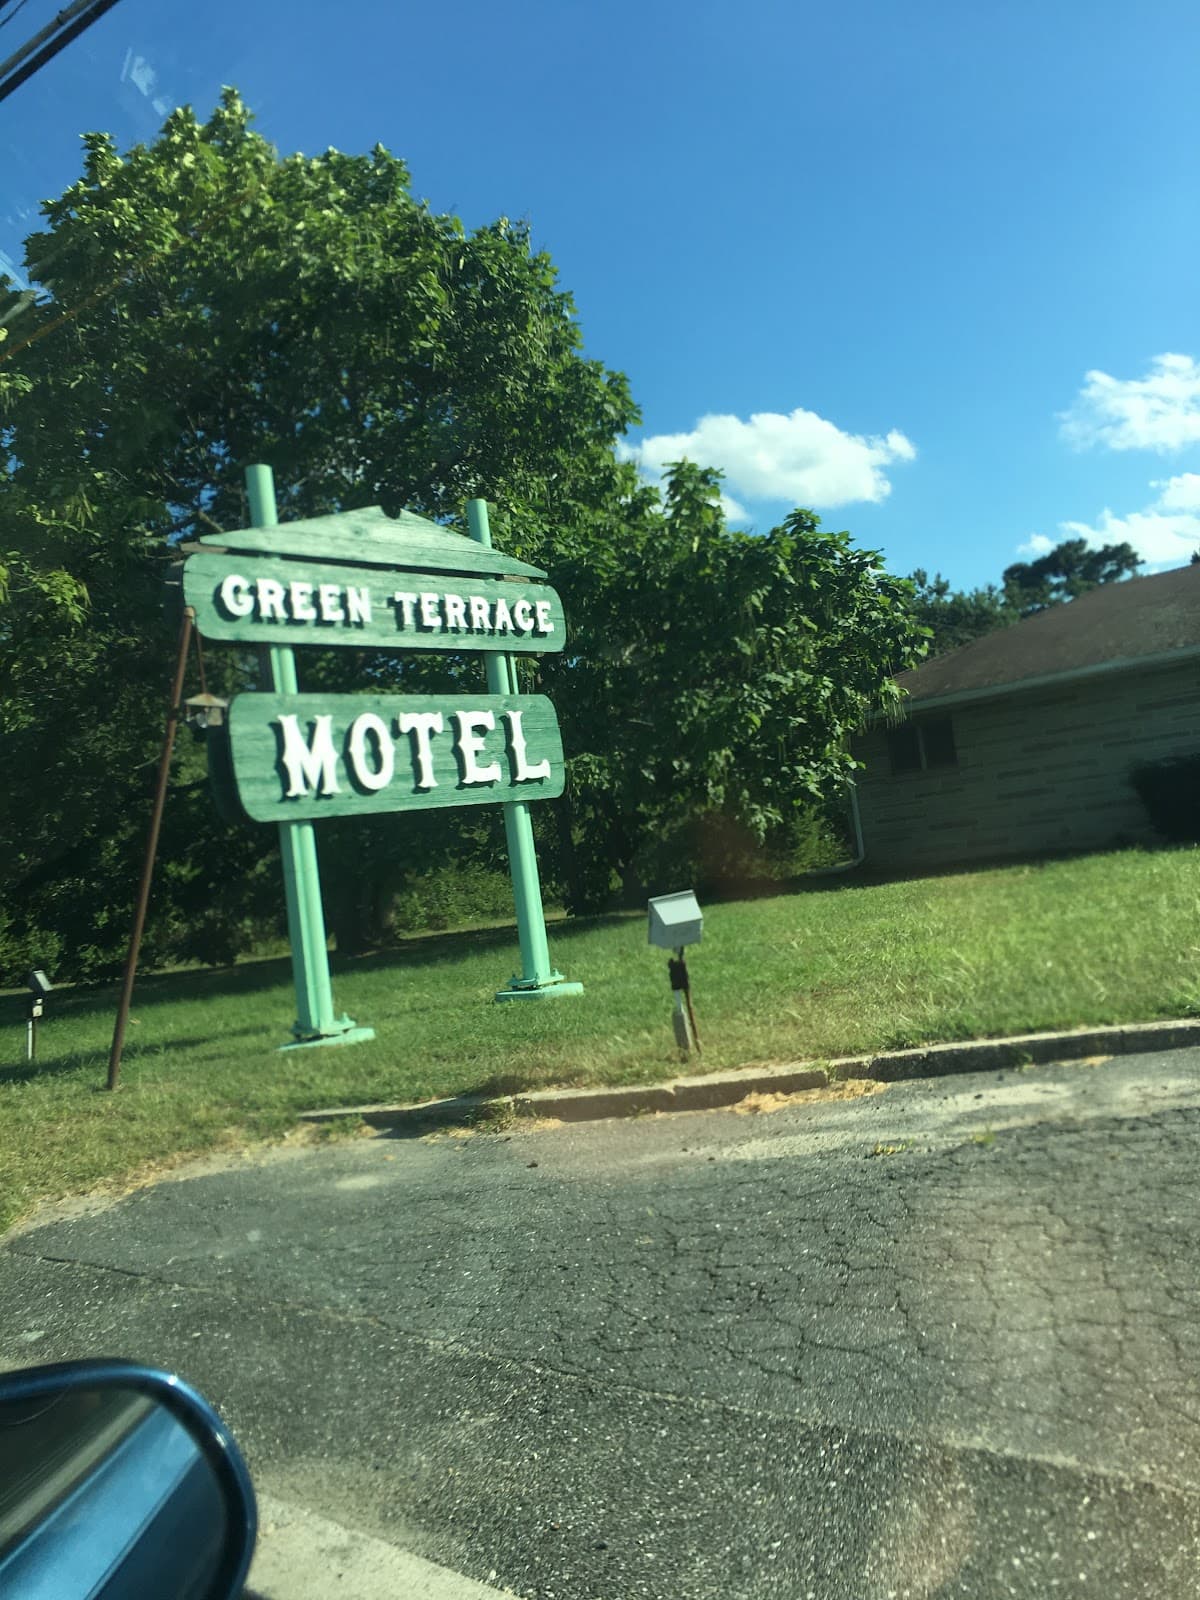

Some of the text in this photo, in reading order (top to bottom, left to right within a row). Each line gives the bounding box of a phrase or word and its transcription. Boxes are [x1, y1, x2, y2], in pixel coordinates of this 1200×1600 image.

[220, 574, 555, 634] GREEN TERRACE
[276, 709, 552, 798] MOTEL
